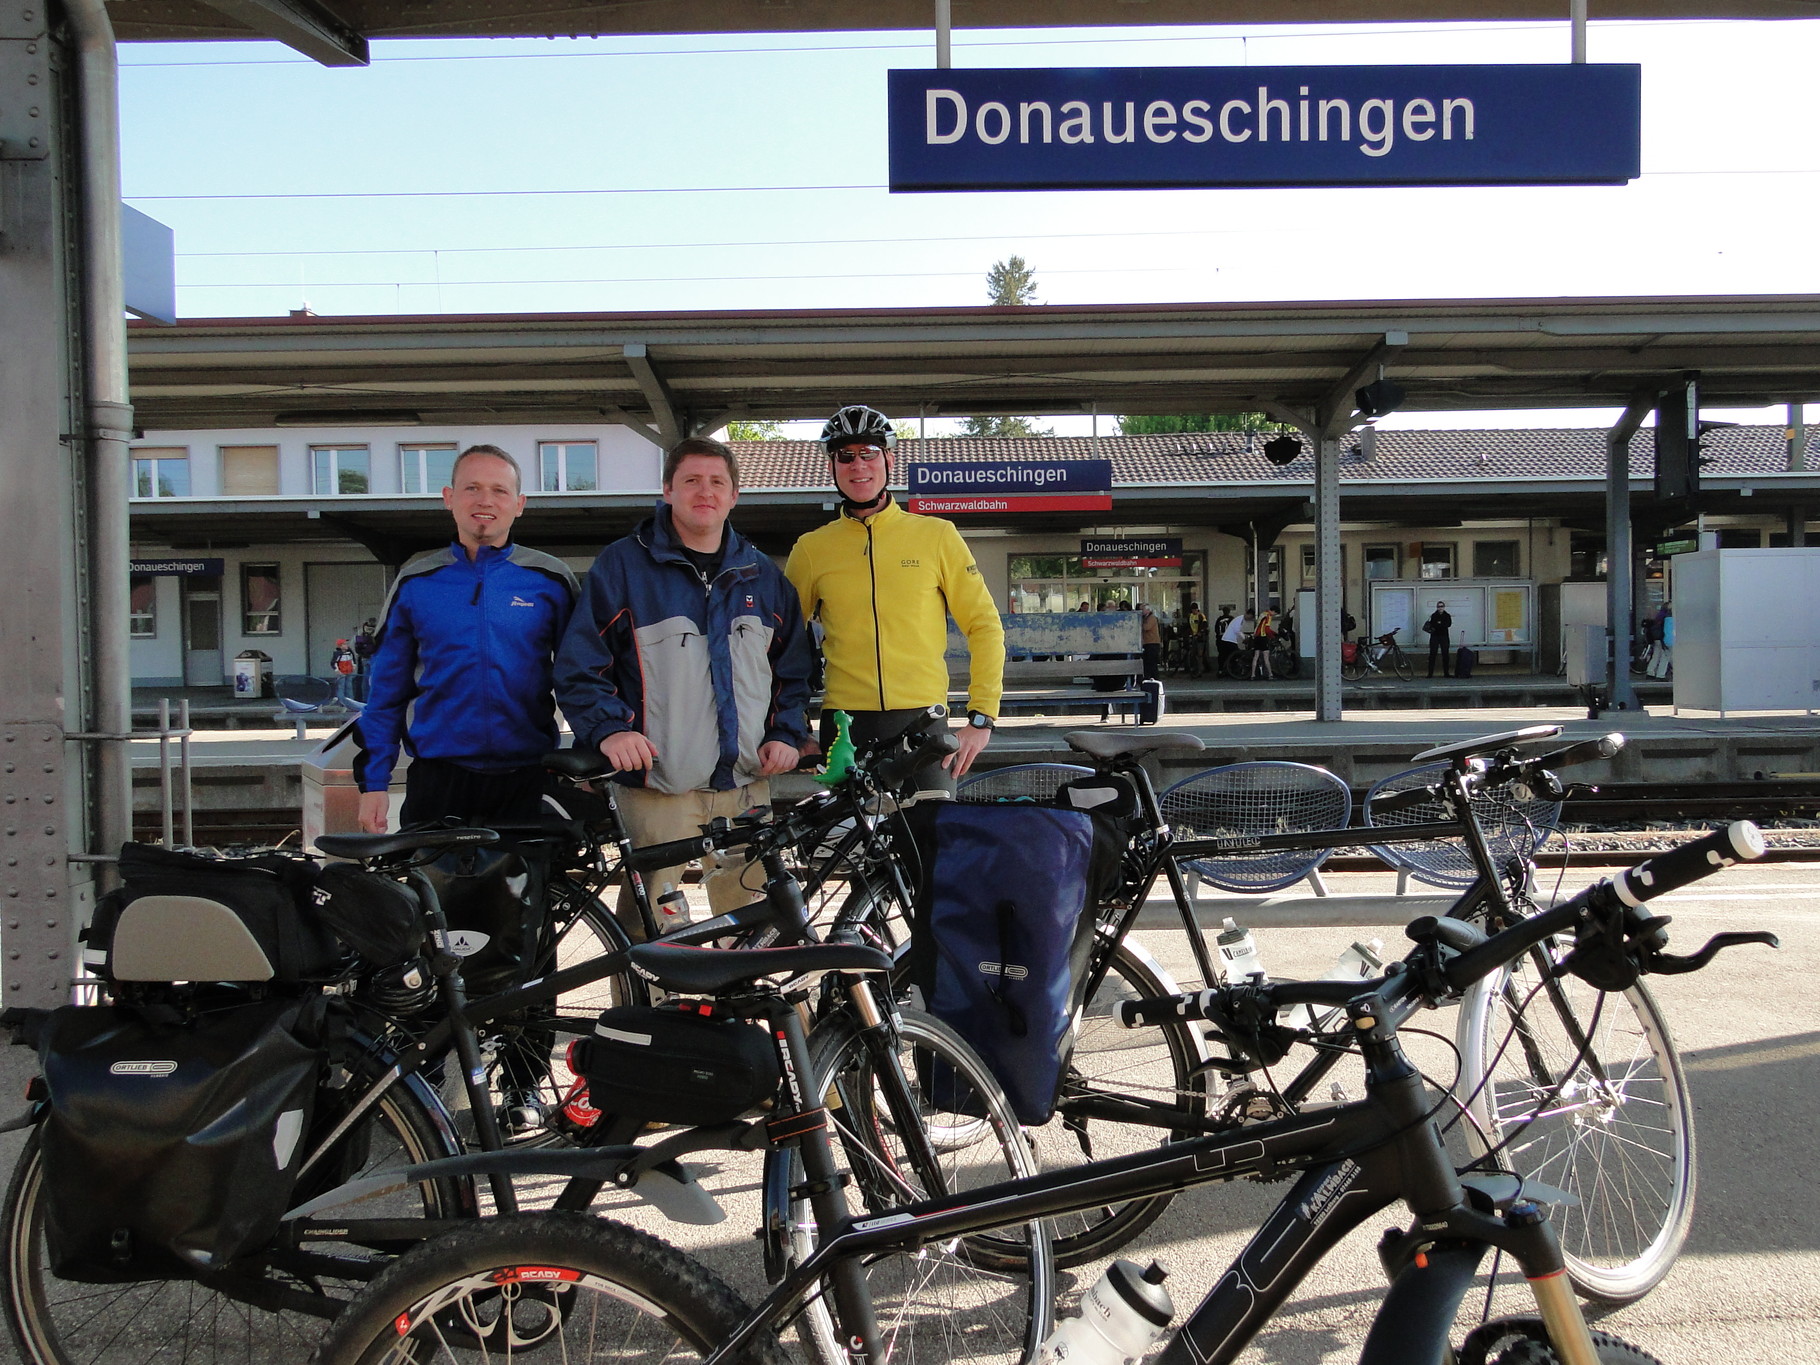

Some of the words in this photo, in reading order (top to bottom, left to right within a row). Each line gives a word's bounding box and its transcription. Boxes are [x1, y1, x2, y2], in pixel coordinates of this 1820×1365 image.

[925, 86, 1475, 158] Donaueschingen
[917, 466, 1067, 486] Donaueschingen
[918, 499, 1008, 511] Schwarzwaldbahn
[1086, 541, 1167, 553] Donaueschingen
[129, 561, 205, 573] Donaueschingen
[780, 1047, 803, 1105] READY
[1310, 1158, 1355, 1213] KALMBACH
[520, 1270, 561, 1280] READY
